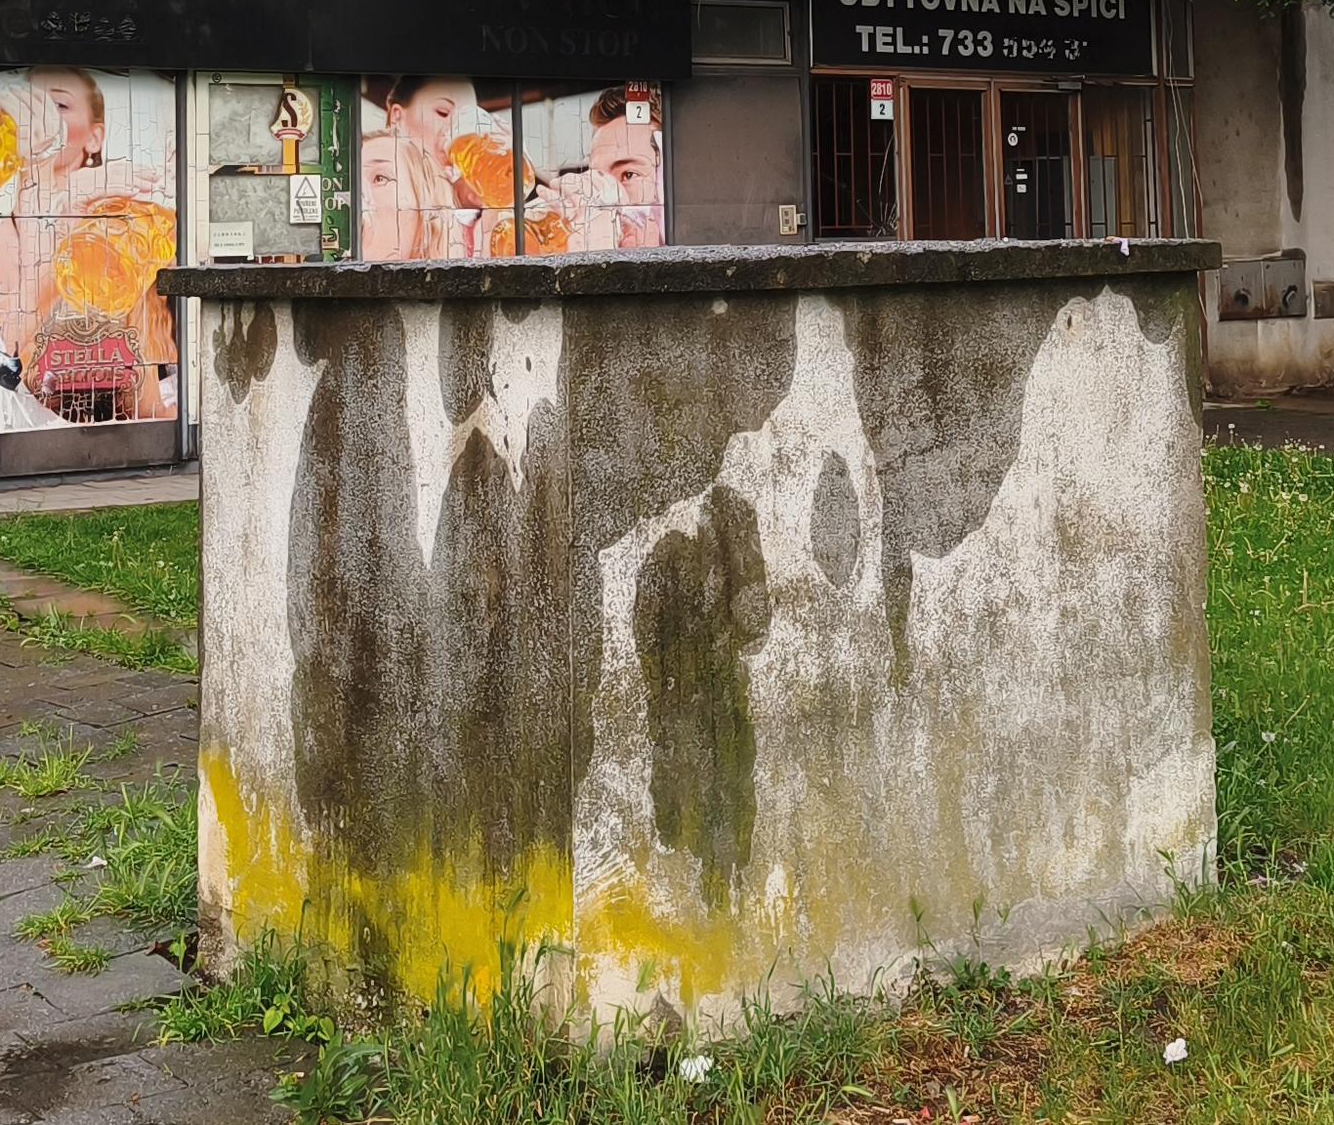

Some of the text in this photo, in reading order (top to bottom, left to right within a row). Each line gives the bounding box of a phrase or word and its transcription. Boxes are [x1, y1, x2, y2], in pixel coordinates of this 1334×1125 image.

[855, 25, 929, 55] TEL.:
[938, 28, 995, 58] 733
[871, 82, 892, 96] 2810
[636, 105, 643, 119] 2
[879, 103, 886, 116] 2
[322, 177, 343, 191] ON
[50, 347, 124, 366] STELLA
